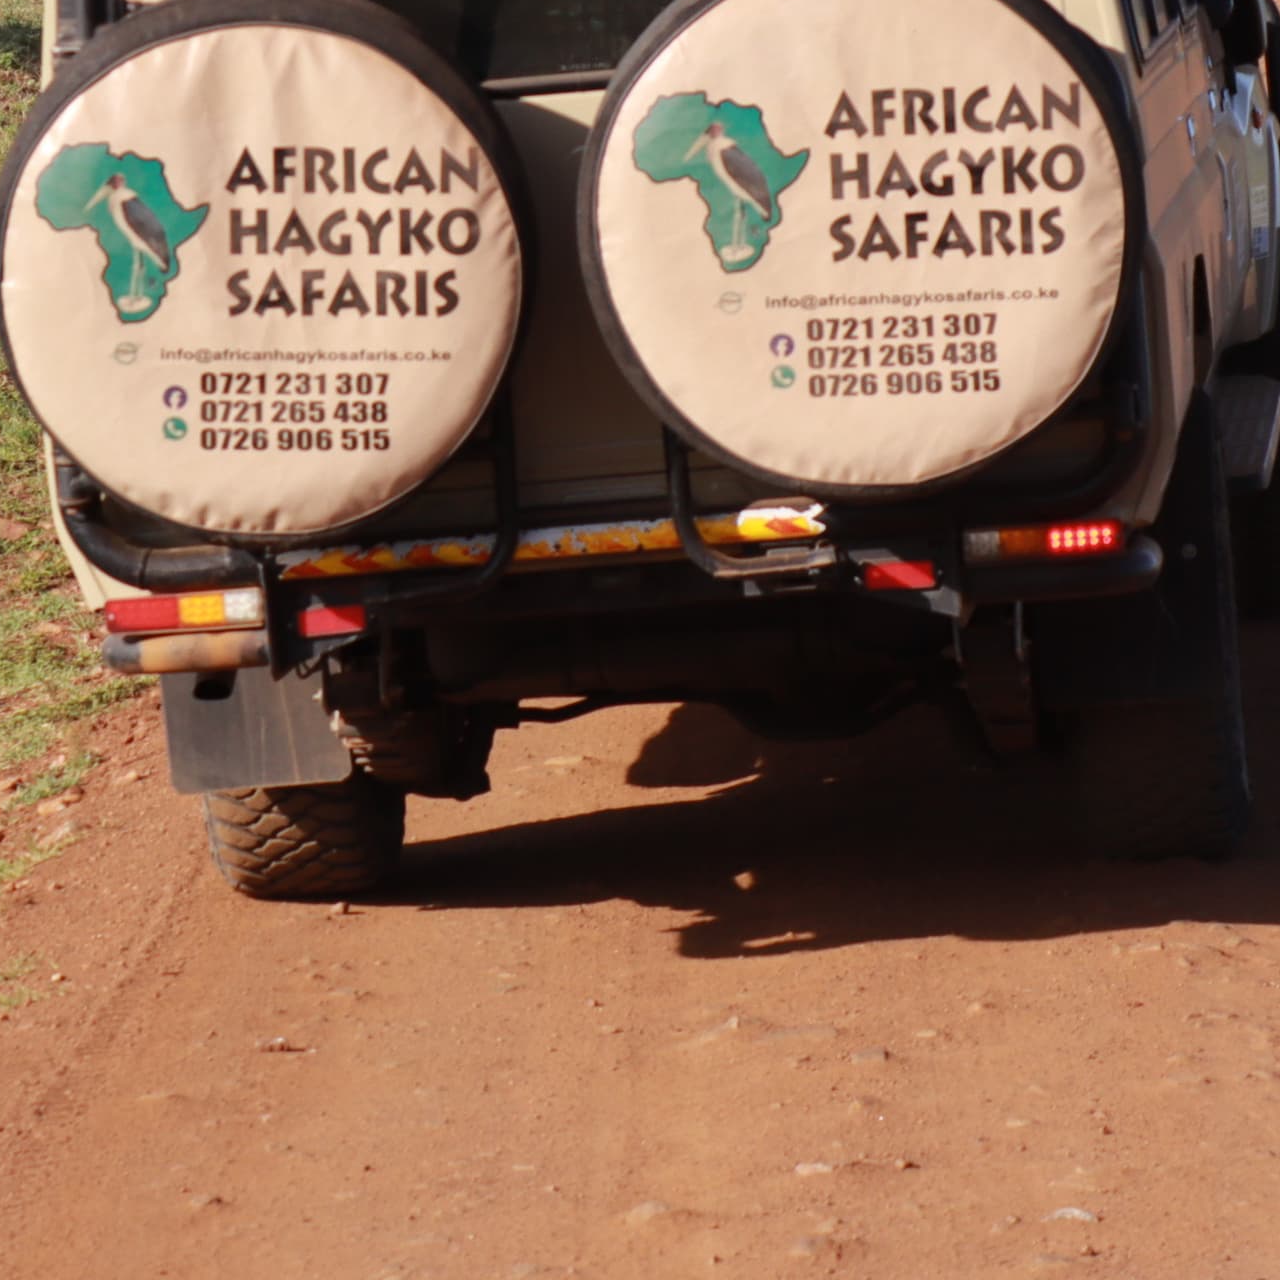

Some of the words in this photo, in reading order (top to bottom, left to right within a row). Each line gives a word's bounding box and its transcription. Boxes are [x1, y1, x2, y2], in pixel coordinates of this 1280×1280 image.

[824, 82, 1081, 139] AFRICAN
[225, 146, 479, 195] AFRICAN
[830, 144, 1086, 200] HAGYKO
[229, 207, 481, 256] HAGYKO
[829, 206, 1065, 263] SAFARIS
[226, 269, 460, 317] SAFARIS
[765, 287, 1060, 310] info@africanhagykosafaris.co.ke
[806, 317, 874, 342] 0721
[882, 315, 935, 340] 231
[943, 312, 998, 336] 307
[160, 347, 452, 365] info@africanhagykosafaris.co.ke
[807, 344, 872, 369] 0721
[879, 343, 934, 368] 265
[941, 341, 998, 365] 438
[200, 371, 267, 396] 0721
[275, 371, 326, 396] 231
[335, 372, 390, 396] 307
[808, 373, 878, 398] 0726
[886, 371, 943, 395] 906
[950, 369, 1001, 393] 515
[200, 400, 264, 423] 0721
[271, 400, 326, 423] 265
[333, 400, 388, 423] 438
[200, 428, 269, 451] 0726
[277, 428, 332, 451] 906
[341, 428, 390, 451] 515
